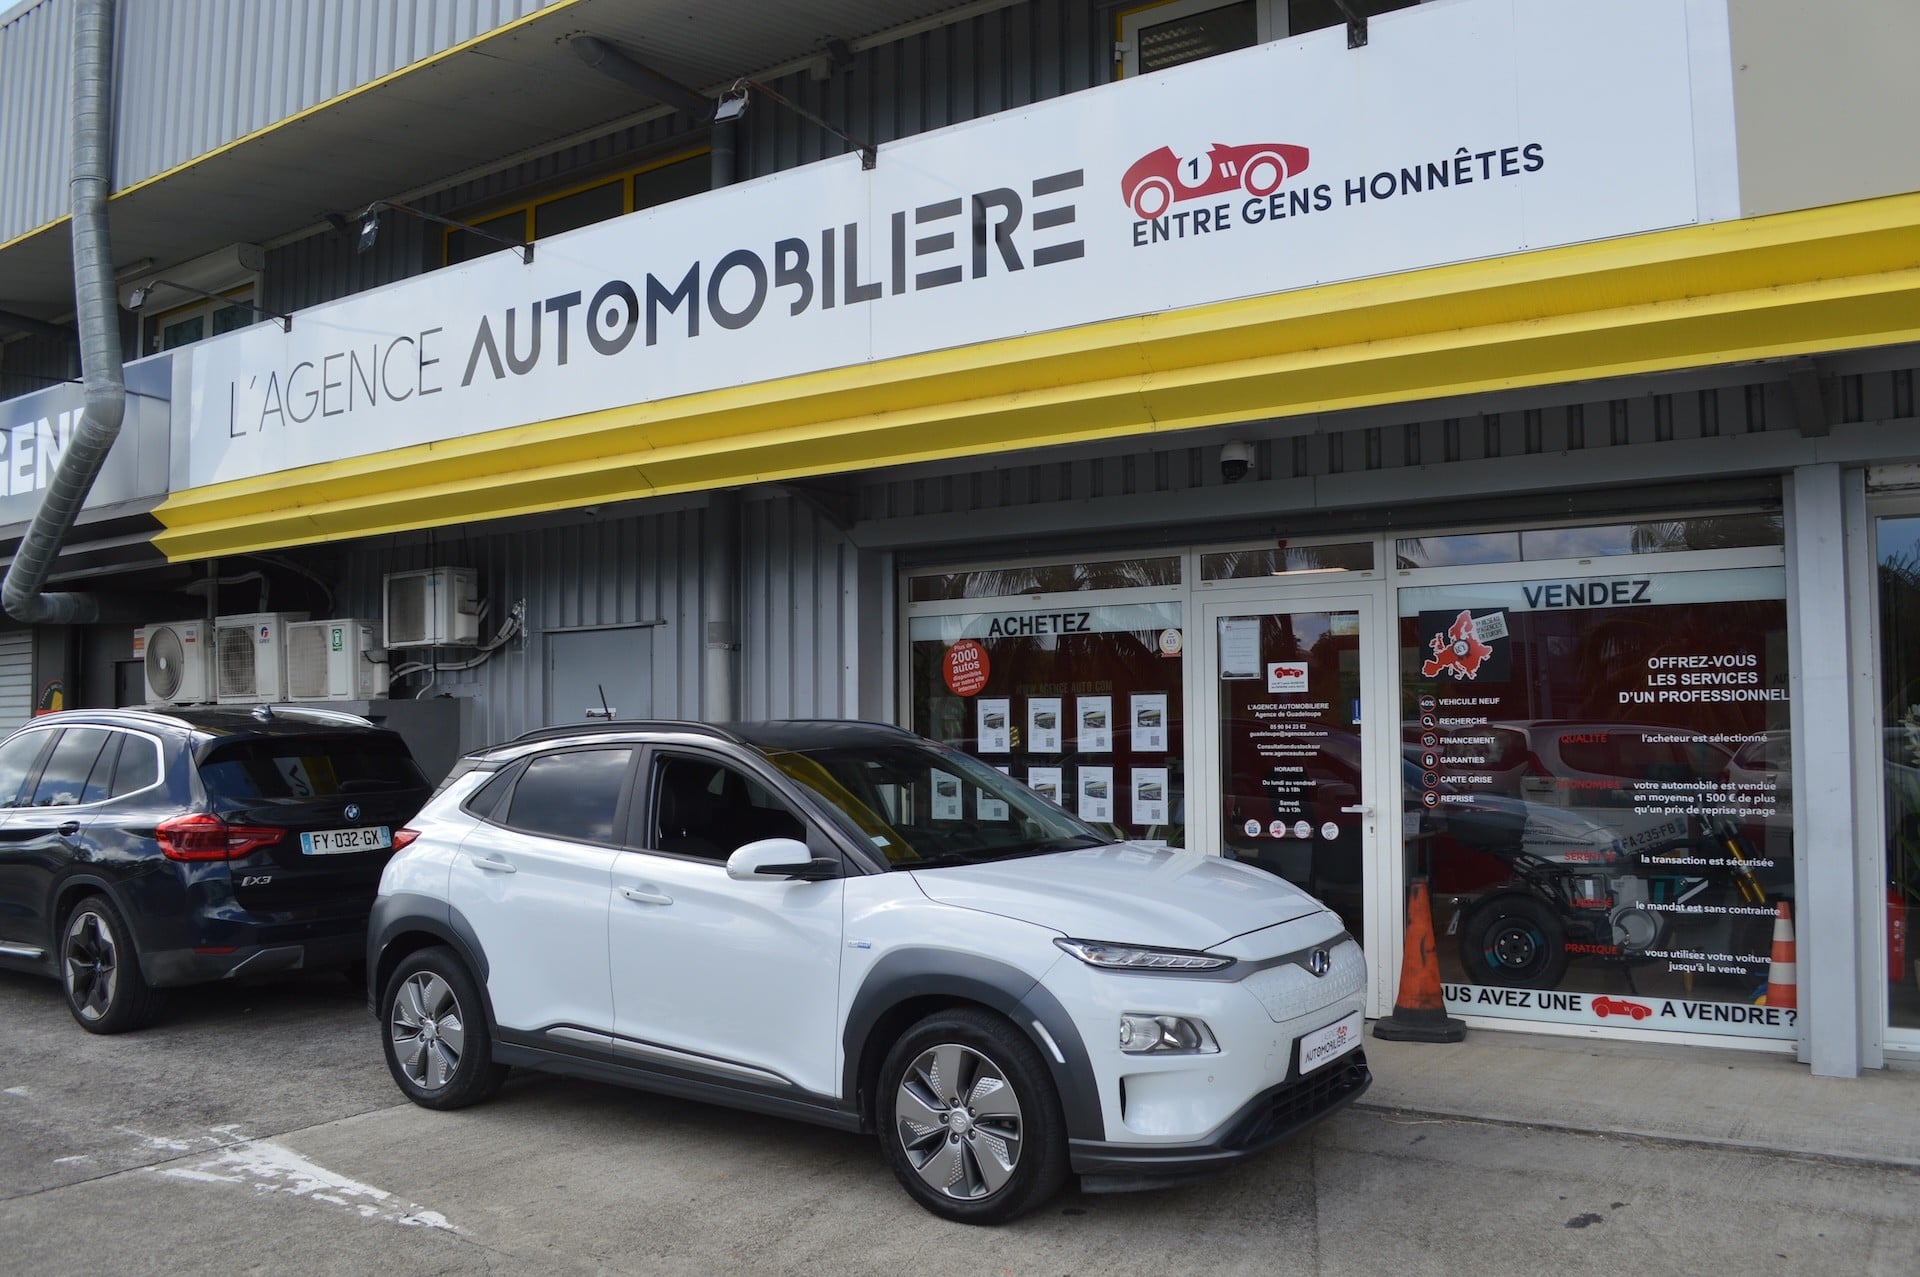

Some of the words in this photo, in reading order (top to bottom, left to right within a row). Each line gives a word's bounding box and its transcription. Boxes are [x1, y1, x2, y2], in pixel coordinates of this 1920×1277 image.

[1133, 203, 1231, 248] ENTRE
[1241, 184, 1333, 226] GENS
[1345, 142, 1545, 205] HONNÊTES
[230, 327, 443, 438] L'AGENCE
[461, 168, 1085, 386] AUTOMOBILIERE
[1523, 580, 1652, 609] VENDEZ
[988, 612, 1091, 637] ACHETEZ
[951, 648, 978, 665] 2000
[1648, 655, 1757, 670] OFFREZ-VOUS
[953, 661, 980, 674] autos
[1648, 673, 1677, 686] LES
[1681, 672, 1758, 685] SERVICES
[1439, 698, 1477, 706] VEHICULE
[1479, 697, 1500, 705] NEUF
[1619, 691, 1655, 704] D'UN
[1659, 689, 1790, 703] PROFESSIONNEL
[1255, 711, 1277, 719] Agence
[1439, 717, 1488, 725] RECHERCHE
[1642, 733, 1691, 743] l'acheteur
[1692, 734, 1707, 743] est
[1709, 733, 1768, 743] sélectionné
[1440, 756, 1485, 764] GARANTIES
[1634, 782, 1659, 790] votre
[1661, 781, 1718, 790] automobile
[1720, 782, 1735, 790] est
[1738, 781, 1777, 791] vendue
[1440, 795, 1475, 803] REPRISE
[1649, 795, 1694, 804] moyenne
[1697, 794, 1703, 802] 1
[1706, 794, 1727, 803] 500
[1729, 794, 1736, 803] €
[1738, 794, 1751, 803] de
[1754, 795, 1776, 805] plus
[1634, 805, 1662, 815] qu'un
[1664, 805, 1684, 815] prix
[1686, 805, 1700, 814] de
[1701, 806, 1737, 816] reprise
[1739, 808, 1776, 818] garage
[312, 830, 380, 849] FY-032-GX
[1641, 854, 1650, 864] la
[1652, 855, 1706, 865] transaction
[1709, 857, 1724, 866] est
[1726, 857, 1775, 867] sécurisée
[1636, 901, 1645, 910] le
[1647, 902, 1685, 912] mandat
[1687, 905, 1702, 913] est
[1729, 907, 1781, 916] contrainte
[1564, 944, 1617, 955] PRATIQUE
[1670, 950, 1705, 960] utilisez
[1707, 954, 1733, 962] votre
[1735, 954, 1772, 964] voiture
[1669, 962, 1704, 973] jusqu'à
[1707, 964, 1715, 973] la
[1718, 967, 1747, 975] vente
[1477, 988, 1531, 1008] AVEZ
[1538, 993, 1581, 1012] UNE
[1660, 1000, 1676, 1018] A
